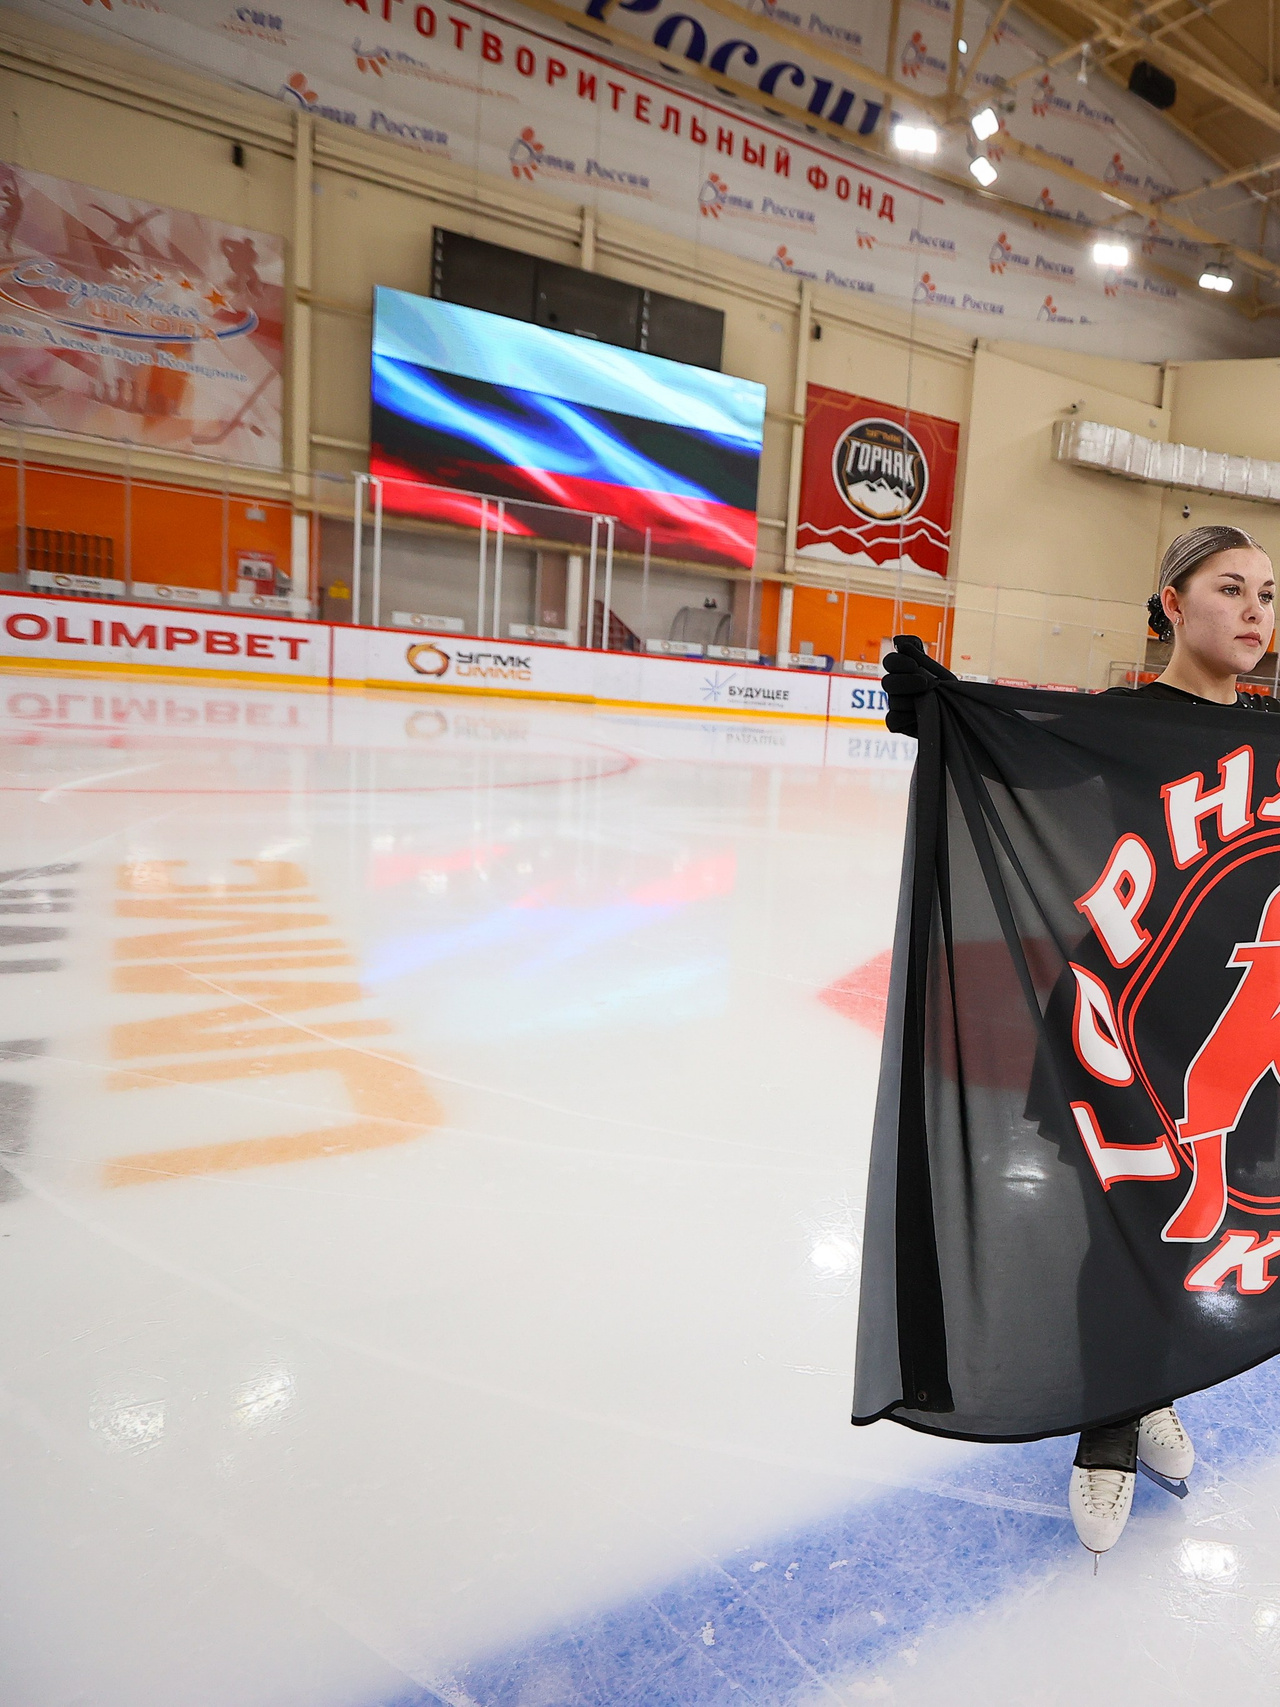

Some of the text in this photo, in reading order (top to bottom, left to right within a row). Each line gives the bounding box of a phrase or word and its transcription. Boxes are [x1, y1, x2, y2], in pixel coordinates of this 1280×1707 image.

[806, 165, 896, 223] ФОНД
[4, 612, 309, 661] OLIMPBET
[456, 651, 531, 669] УГМК
[728, 685, 790, 702] БУДУЩЕЕ
